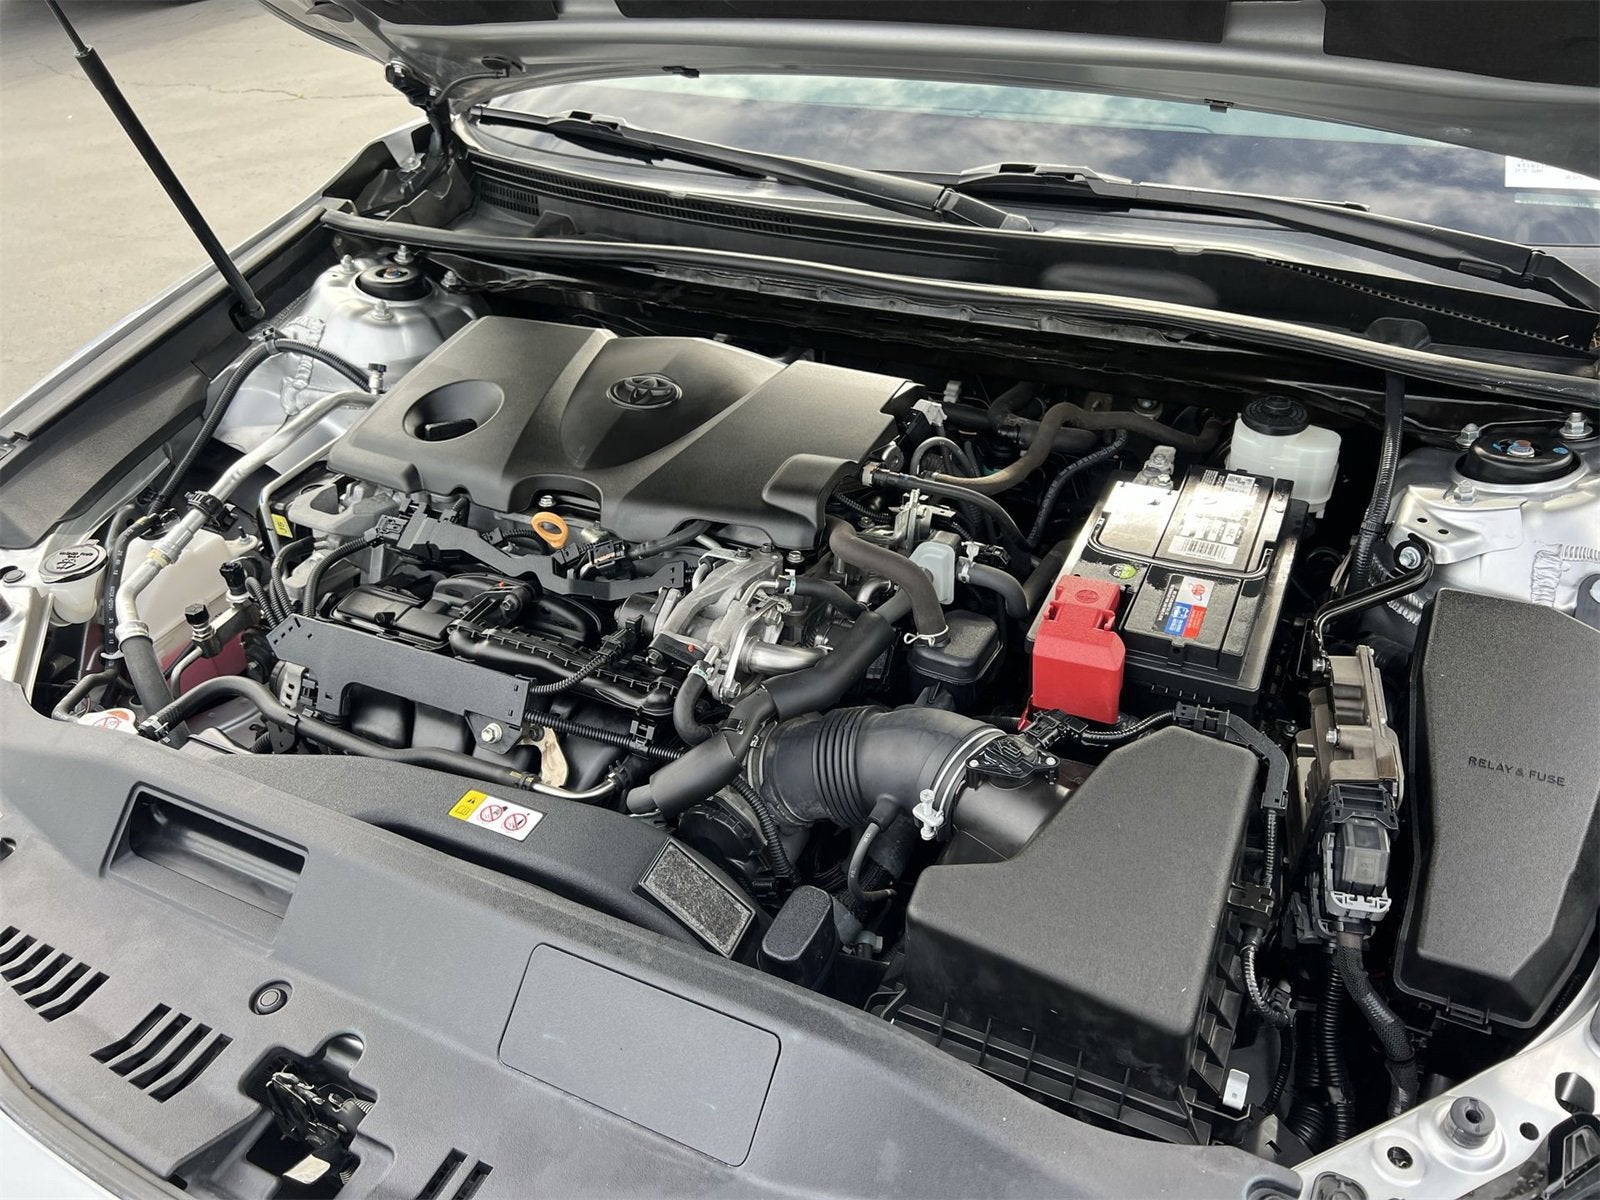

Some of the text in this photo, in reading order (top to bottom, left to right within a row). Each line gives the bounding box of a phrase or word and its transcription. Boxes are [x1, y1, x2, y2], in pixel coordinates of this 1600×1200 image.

[1468, 756, 1566, 787] RELAY & FUSE
